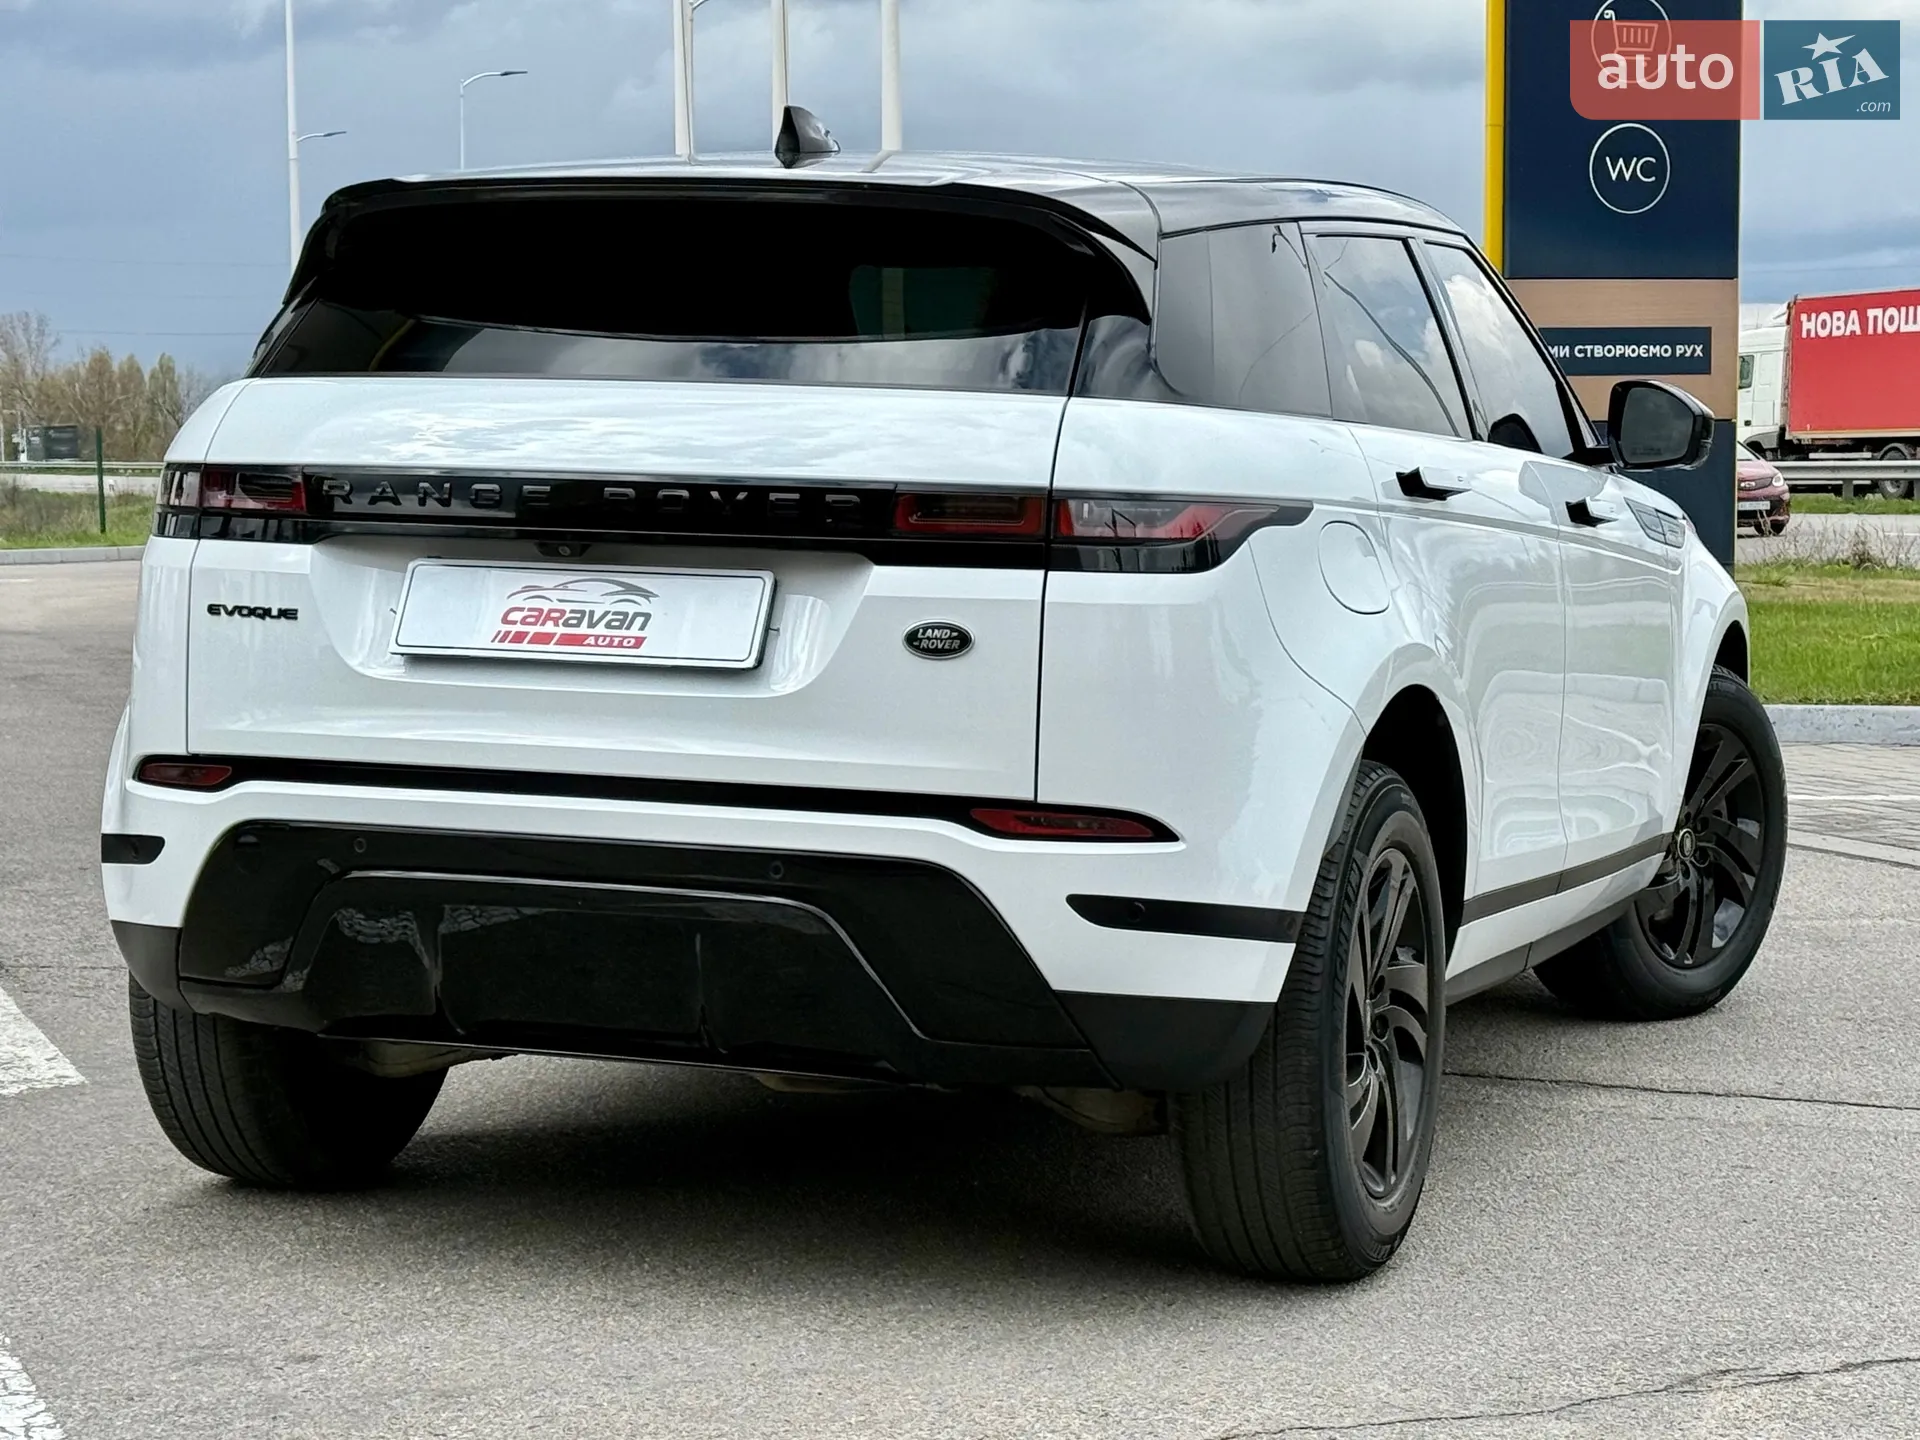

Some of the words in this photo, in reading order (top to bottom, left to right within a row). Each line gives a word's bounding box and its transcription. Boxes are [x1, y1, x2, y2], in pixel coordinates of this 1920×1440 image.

[1605, 156, 1656, 182] WC
[1800, 310, 1862, 339] НОВА
[1867, 305, 1920, 335] ПОШ
[1574, 344, 1672, 358] СТВОРЮЄМО
[1676, 344, 1704, 358] РУХ
[322, 479, 552, 508] RANGE
[603, 487, 865, 526] ROVER
[207, 603, 299, 621] EVOQUE
[582, 636, 636, 647] AUTO
[917, 628, 951, 639] LAND
[920, 639, 960, 650] ROVER
